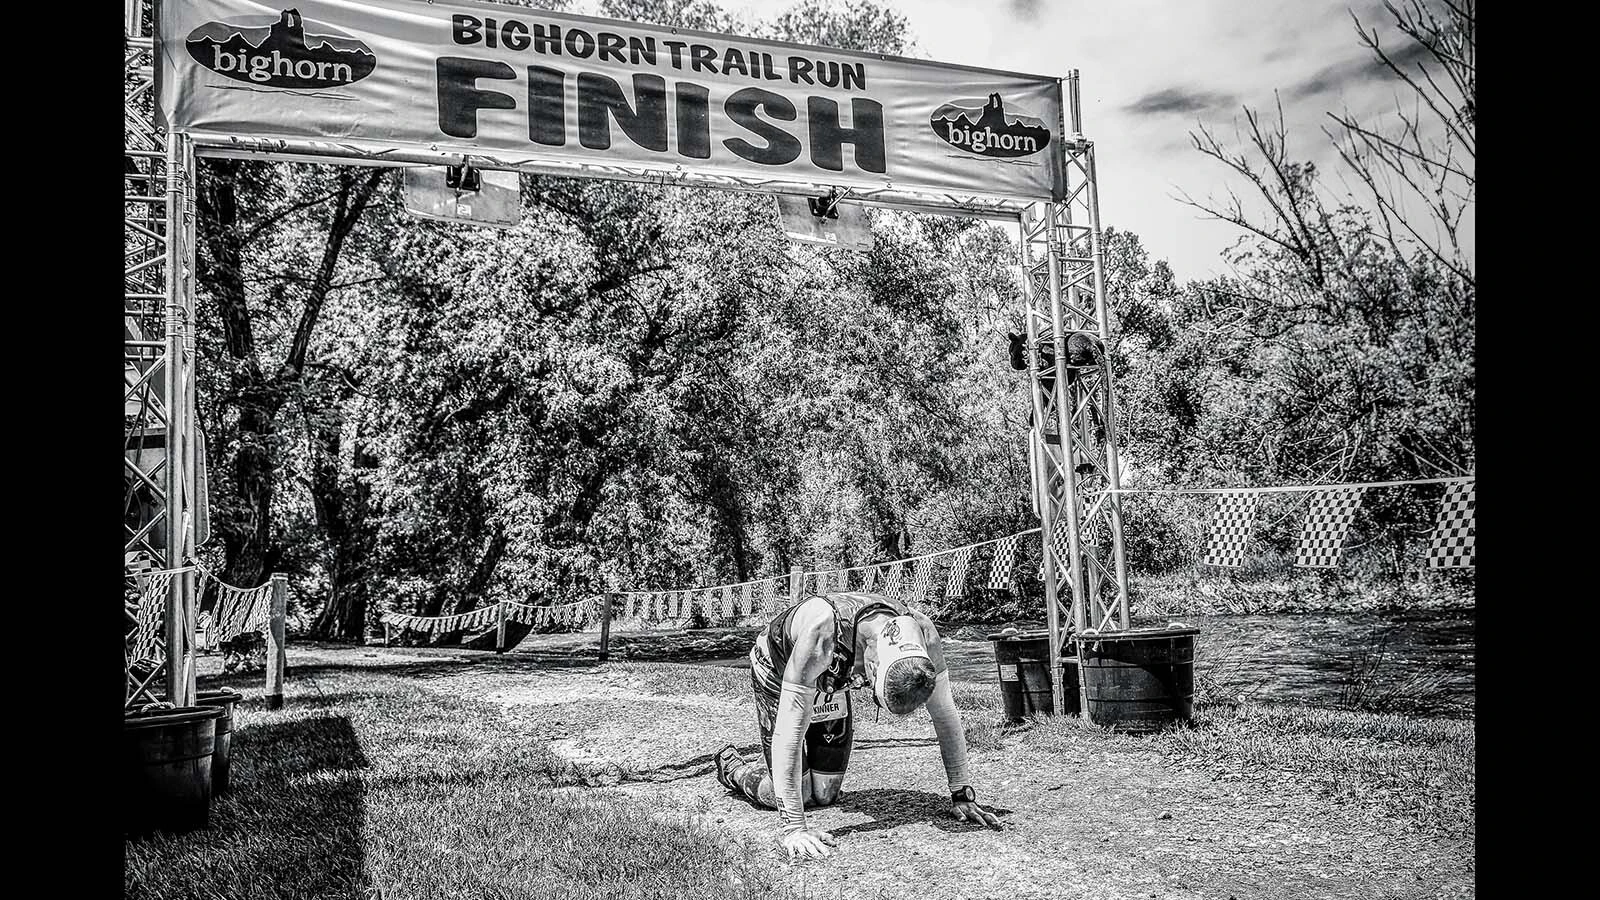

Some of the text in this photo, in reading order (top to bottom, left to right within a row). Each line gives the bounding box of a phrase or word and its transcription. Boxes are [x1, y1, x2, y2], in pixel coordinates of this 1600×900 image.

[211, 44, 353, 82] bighorn
[451, 13, 866, 91] BIGHORN TRAIL RUN
[436, 56, 886, 174] FINISH
[946, 121, 1038, 153] bighorn
